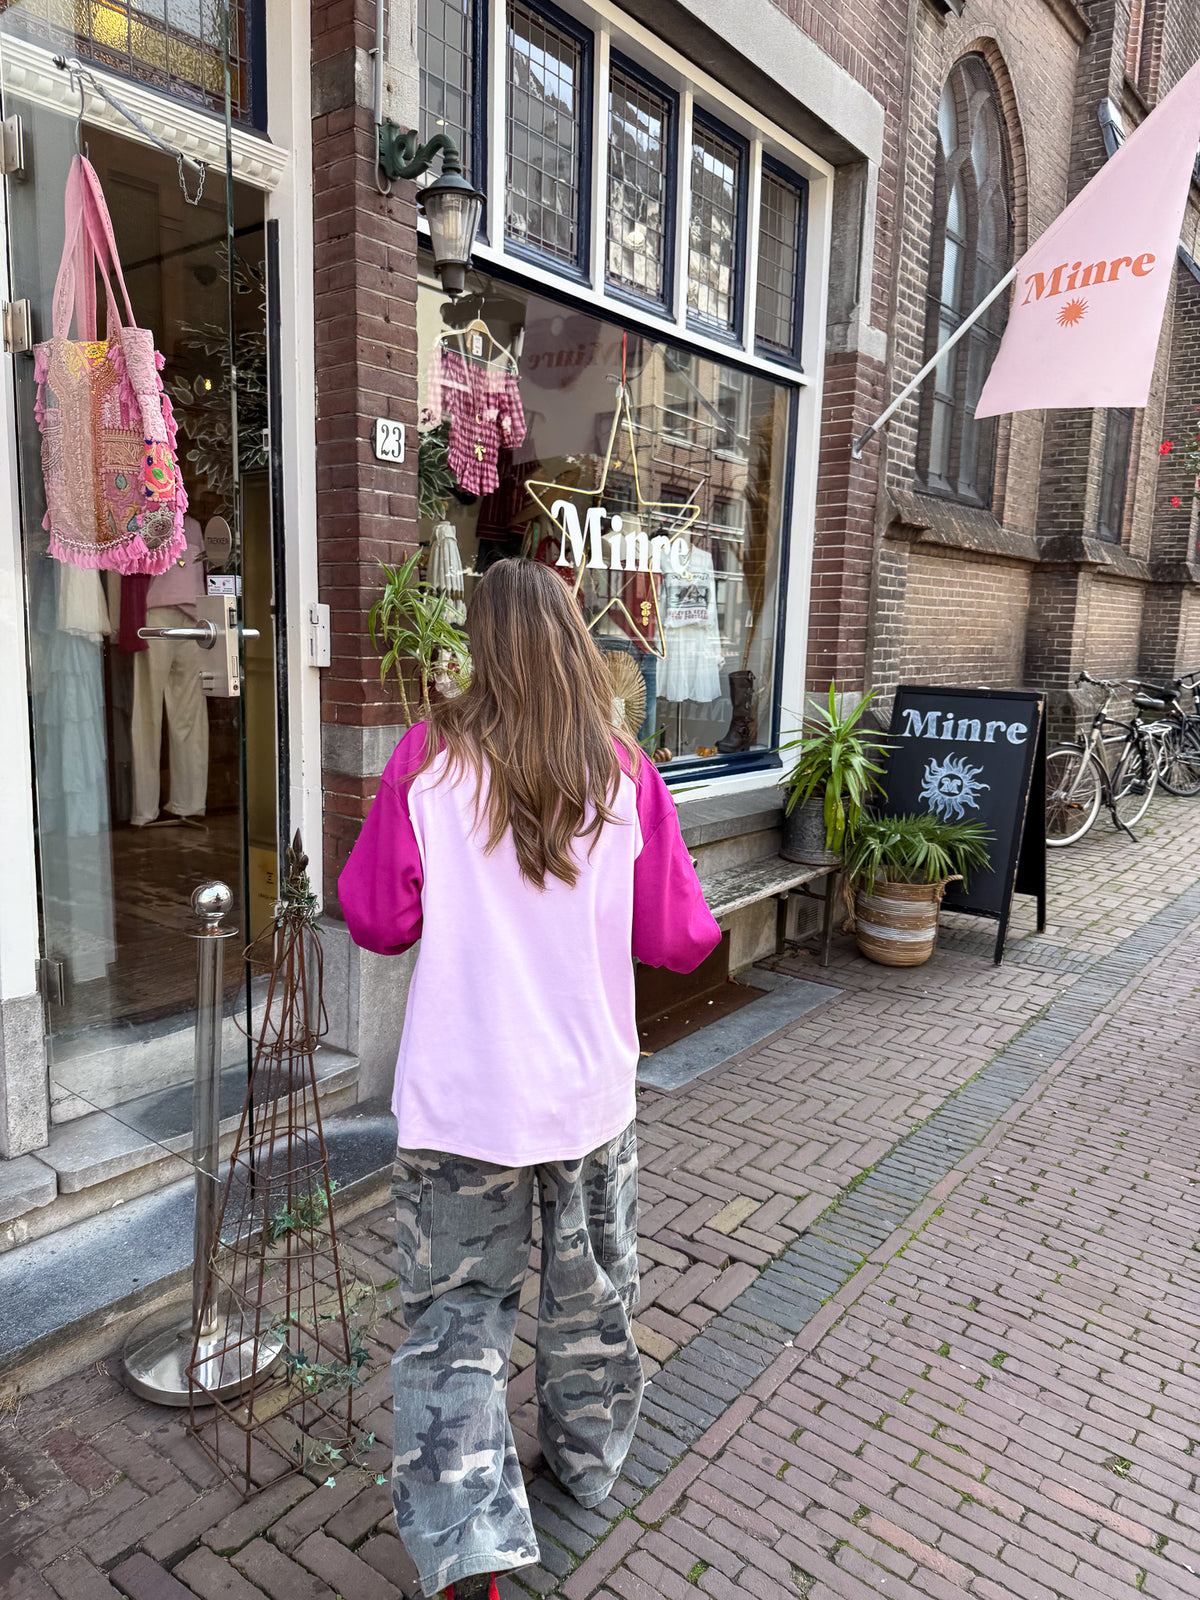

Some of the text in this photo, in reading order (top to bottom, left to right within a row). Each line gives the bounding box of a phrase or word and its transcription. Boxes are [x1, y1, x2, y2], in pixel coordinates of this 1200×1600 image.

[1021, 252, 1156, 306] Minre
[380, 423, 402, 459] 23
[550, 499, 691, 573] Minre
[902, 708, 1029, 745] Minre
[939, 776, 962, 794] M
